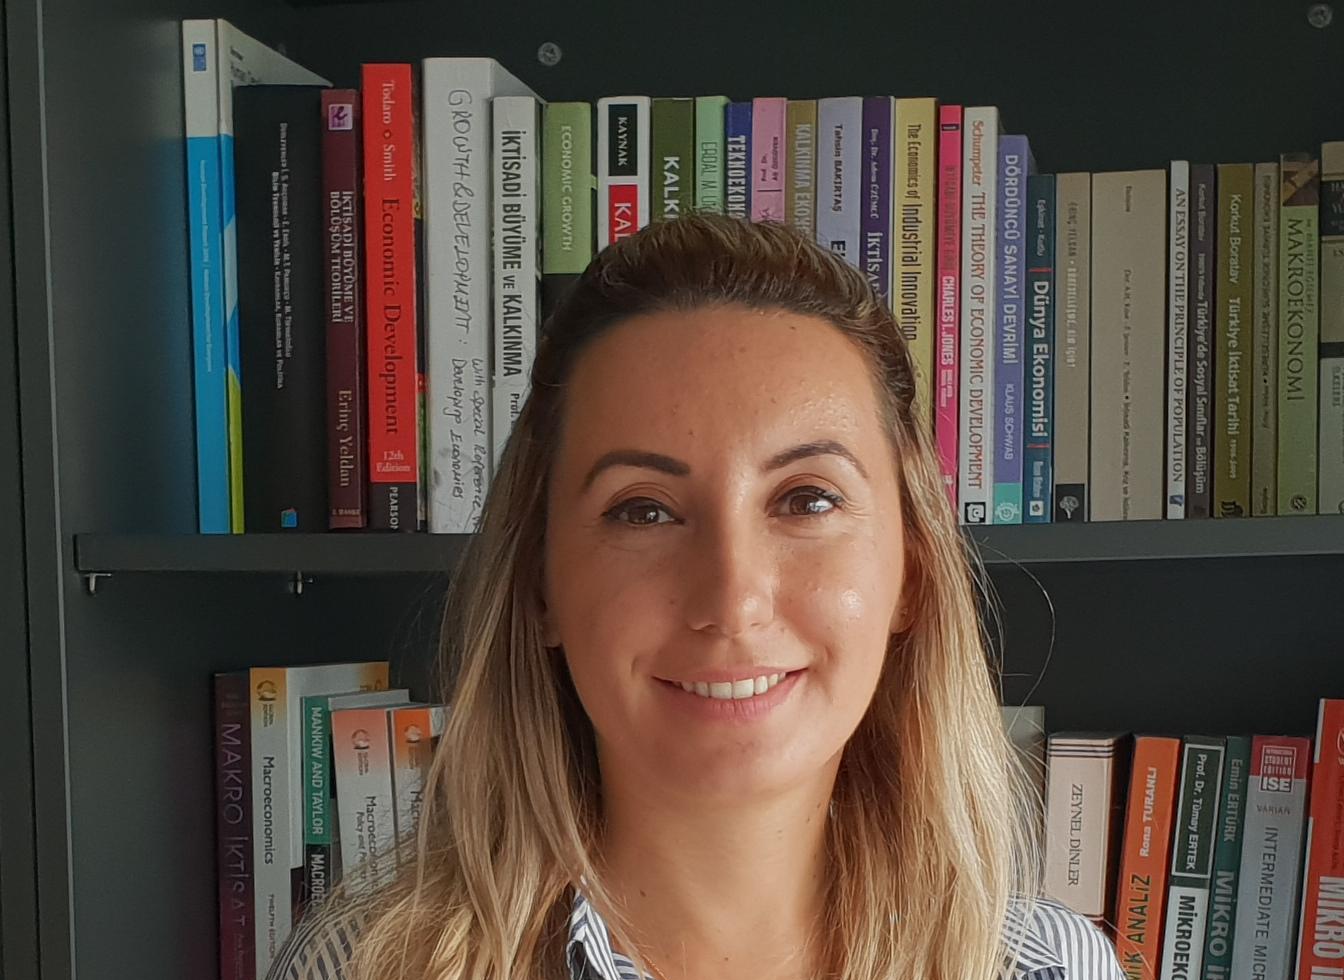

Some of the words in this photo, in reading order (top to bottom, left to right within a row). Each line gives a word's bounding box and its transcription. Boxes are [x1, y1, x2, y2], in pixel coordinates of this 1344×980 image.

[381, 79, 396, 124] Todaro
[448, 89, 472, 178] GROWTH
[616, 116, 628, 166] KAYNAK
[793, 123, 811, 188] KALKINMA
[907, 123, 922, 139] The
[969, 119, 983, 186] Schumpeter
[381, 143, 396, 182] Smith
[501, 129, 527, 197] İKTİSADİ
[560, 125, 572, 192] ECONOMIC
[700, 140, 717, 175] ERDAL
[905, 140, 921, 188] Economics
[341, 190, 355, 247] İKTİSADİ
[904, 189, 921, 199] of
[970, 192, 986, 220] THE
[1003, 154, 1021, 240] DÖRDÜNCÜ
[1173, 187, 1184, 207] AN
[1229, 193, 1241, 233] Korkut
[381, 197, 402, 296] Economic
[501, 203, 526, 269] BÜYÜME
[560, 195, 572, 251] GROWTH
[900, 203, 923, 267] Industrial
[1173, 209, 1184, 249] ESSAY
[342, 250, 355, 302] BÜYÜME
[969, 223, 985, 280] THEORY
[1002, 244, 1020, 299] SANAYİ
[1172, 251, 1184, 271] ON
[1228, 236, 1240, 283] Boratav
[502, 275, 515, 288] VE
[941, 275, 956, 322] CHARLES
[970, 284, 984, 304] OF
[343, 305, 353, 323] VE
[1001, 303, 1019, 364] DEVRİMİ
[1028, 280, 1049, 338] Dünya
[1194, 300, 1208, 358] Türkiye'de
[1225, 296, 1240, 348] Türkiye
[1286, 218, 1305, 401] MAKROEKONOMİ
[502, 294, 521, 377] KALKINMA
[940, 330, 953, 365] JONES
[968, 308, 984, 385] ECONOMIC
[1171, 304, 1183, 374] PRINCIPLE
[376, 304, 403, 435] Development
[1029, 343, 1048, 438] Ekonomisi
[1170, 377, 1182, 394] OF
[1192, 360, 1207, 395] Sosyal
[335, 389, 352, 431] Erinç
[1004, 383, 1014, 414] KLAUS
[1226, 396, 1239, 435] Tarihi
[338, 435, 354, 486] Yeldan
[967, 388, 983, 489] DEVELOPMENT
[1004, 416, 1014, 460] SCHWAB
[1169, 396, 1182, 482] POPULATION
[1190, 445, 1204, 494] Bölüşüm
[310, 706, 324, 758] MANKIW
[220, 722, 243, 824] MAKRO
[311, 761, 324, 787] AND
[1192, 779, 1204, 796] Dr.
[1194, 753, 1206, 779] Prof.
[1227, 757, 1243, 790] Emin
[1262, 778, 1290, 790] ISE
[261, 755, 278, 865] Macroeconomics
[311, 789, 324, 834] TAYLOR
[1069, 783, 1083, 837] ZEYNEL
[1142, 765, 1157, 823] TURANLI
[1186, 796, 1203, 832] Tümay
[1221, 792, 1240, 843] ERTÜRK
[1067, 838, 1083, 887] DİNLER
[1184, 833, 1198, 870] ERTEK
[222, 835, 249, 927] İKTİSAT
[1253, 826, 1280, 939] INTERMEDIATE
[1124, 873, 1151, 944] ANALİZ
[1207, 868, 1240, 958] MİKRO
